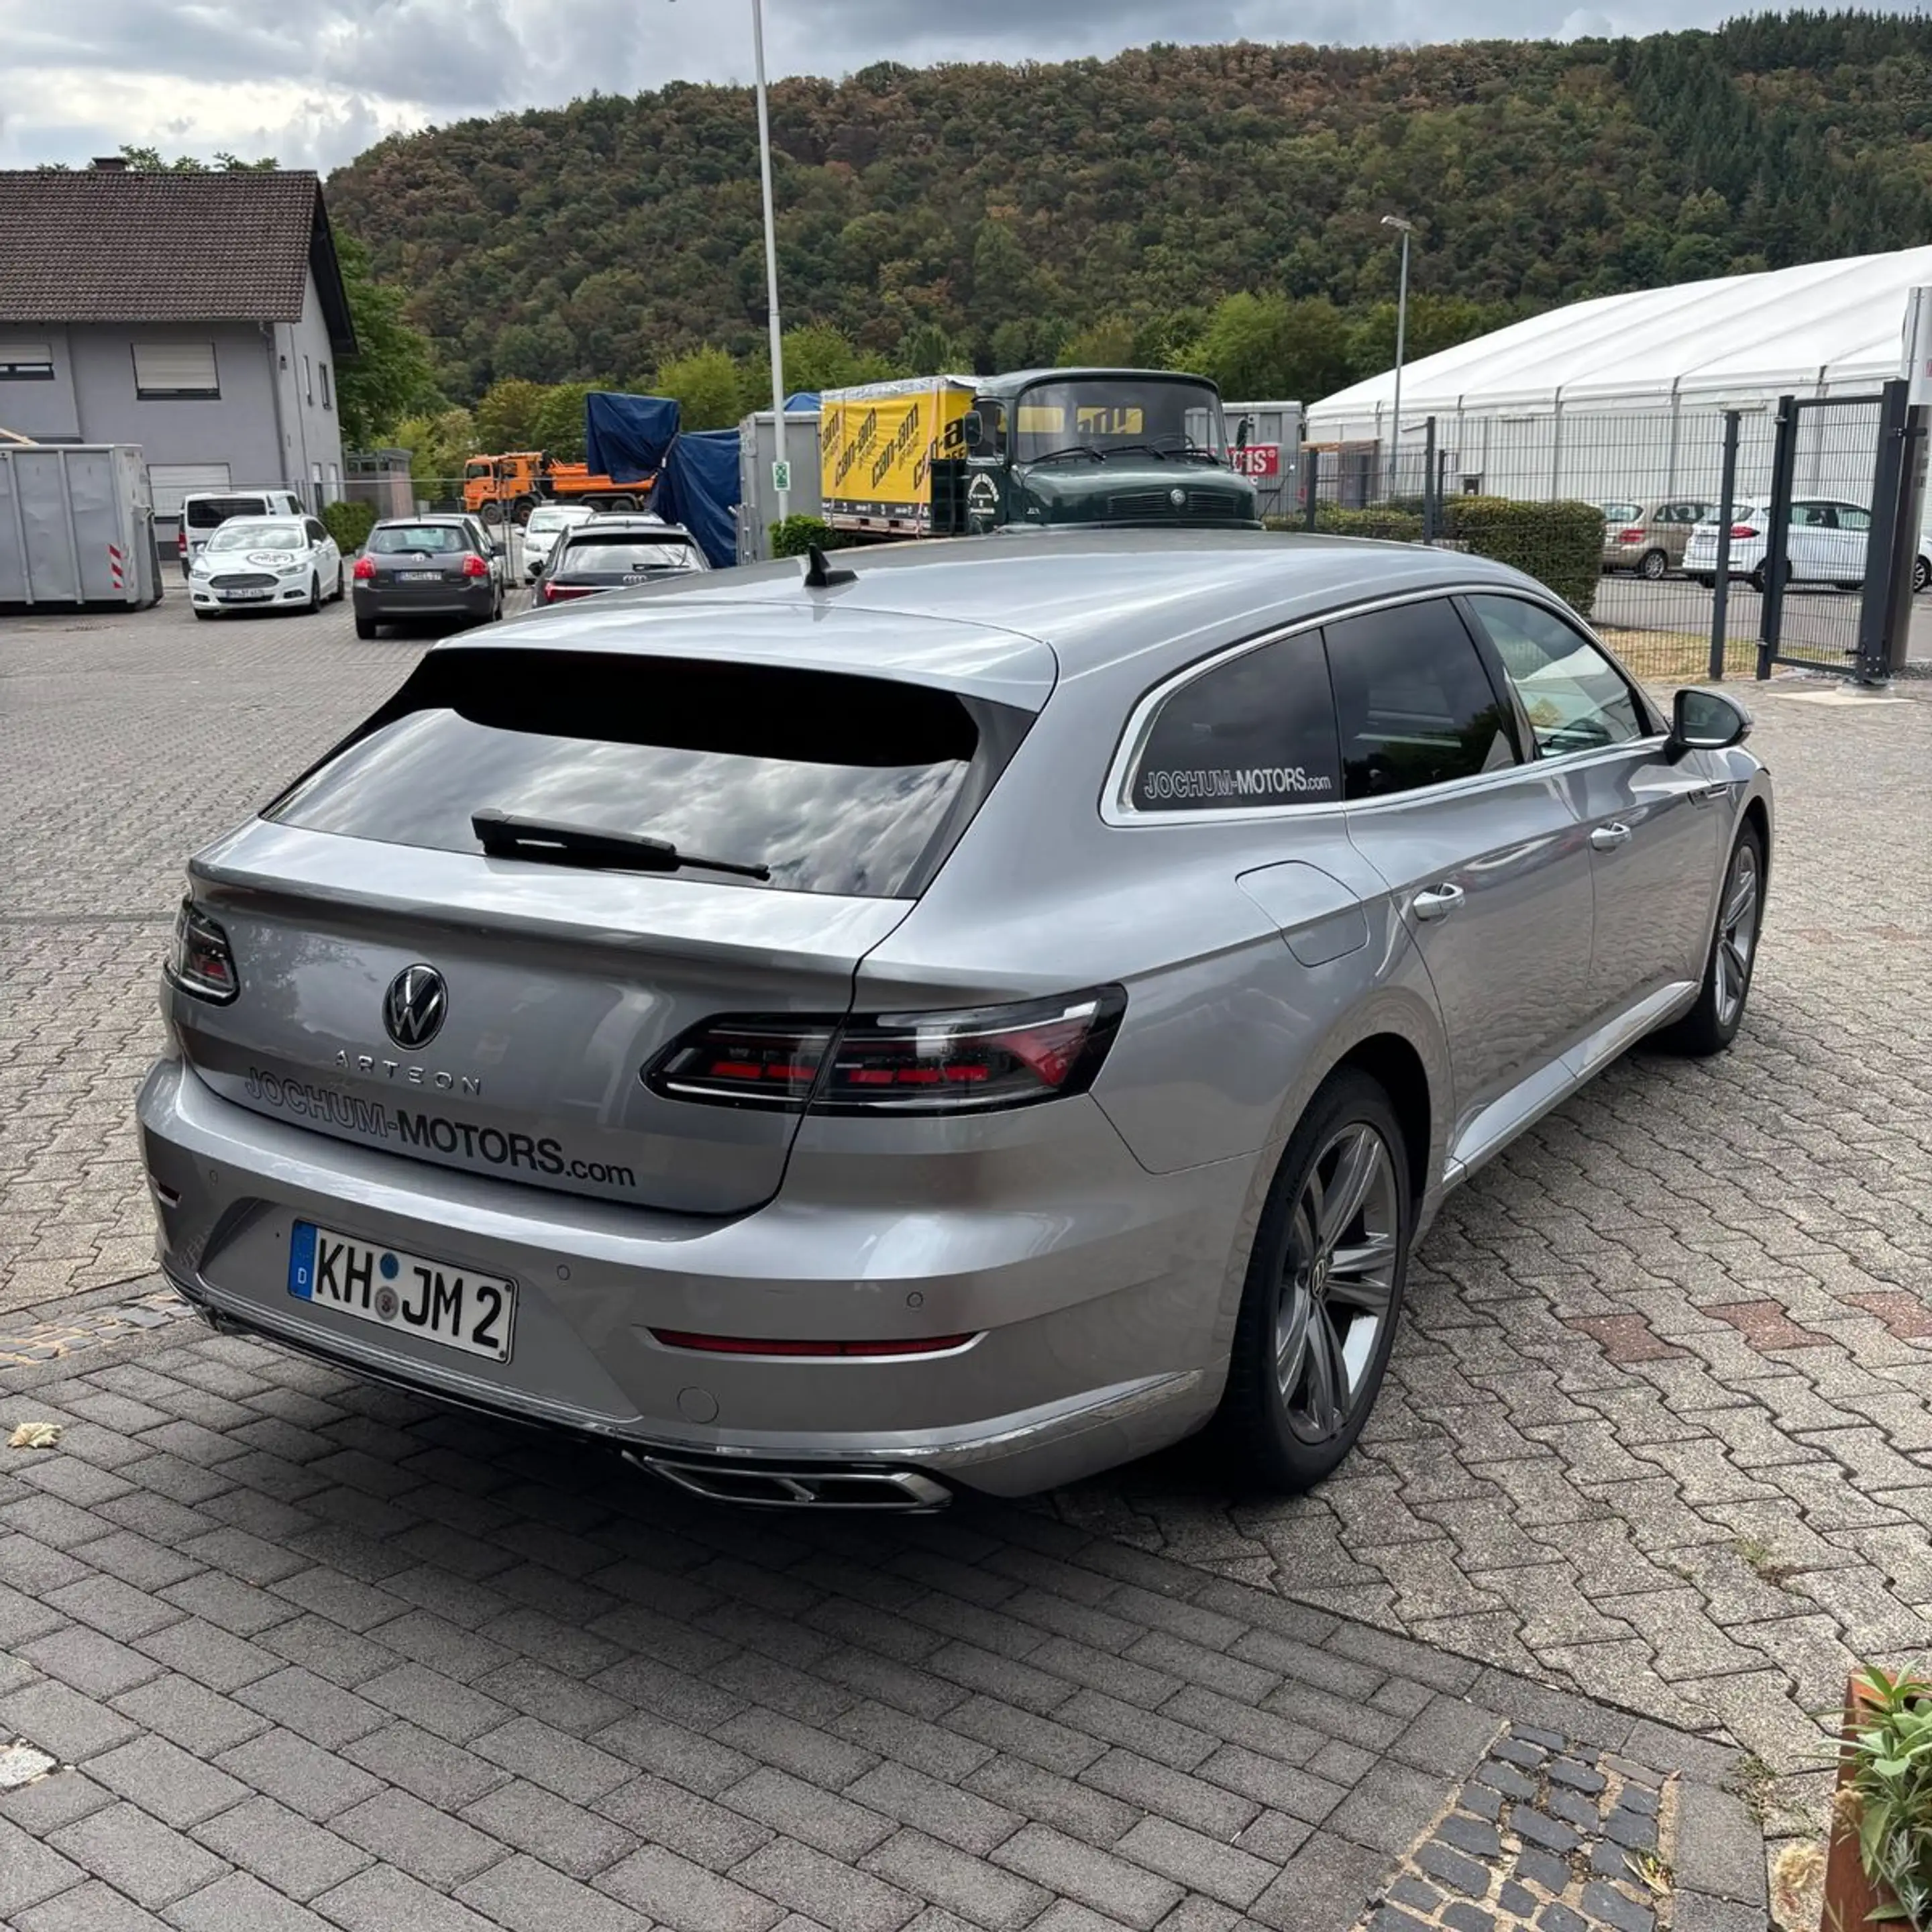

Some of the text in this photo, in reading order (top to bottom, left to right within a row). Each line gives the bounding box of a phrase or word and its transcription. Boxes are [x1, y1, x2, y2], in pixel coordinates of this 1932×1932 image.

[873, 402, 919, 490] can-am
[1144, 767, 1332, 799] JOCHUM-MOTORS.com
[335, 1049, 482, 1096] ARTEON
[244, 1067, 637, 1187] JOCHUM-MOTORS.com
[297, 1267, 307, 1285] D
[316, 1238, 502, 1349] KH JM 2
